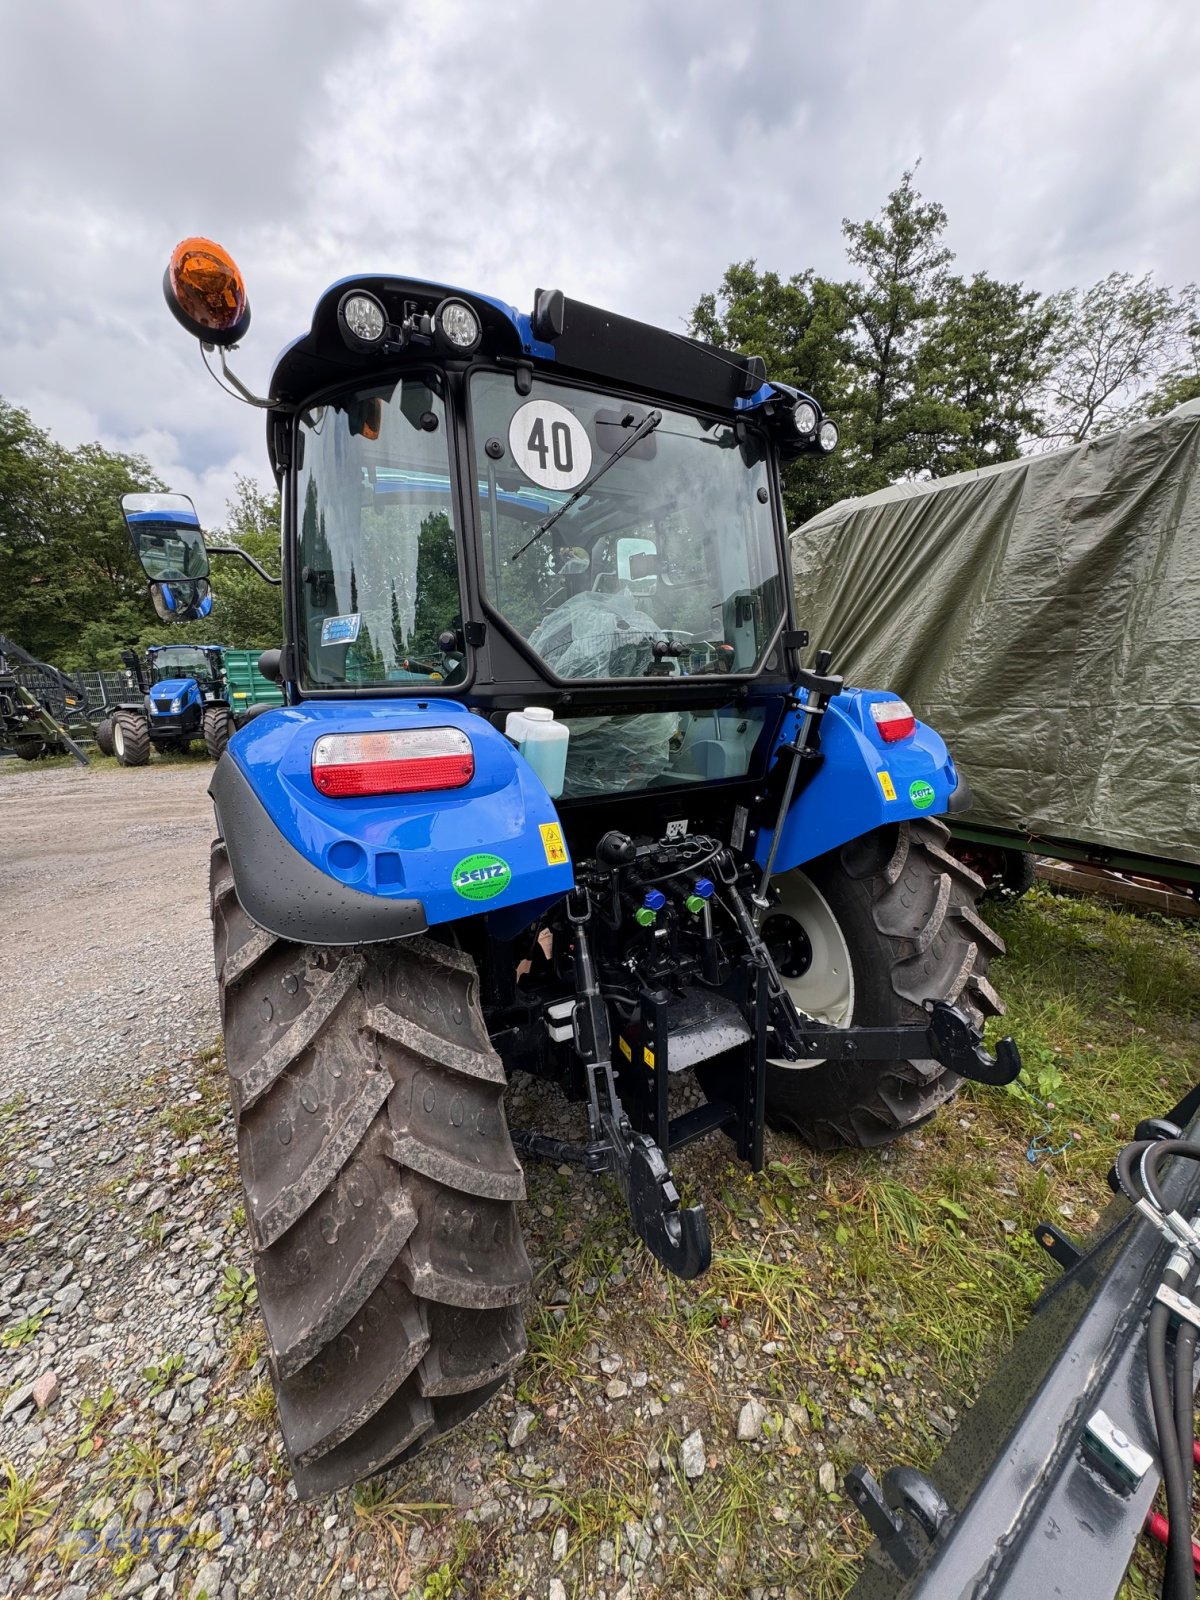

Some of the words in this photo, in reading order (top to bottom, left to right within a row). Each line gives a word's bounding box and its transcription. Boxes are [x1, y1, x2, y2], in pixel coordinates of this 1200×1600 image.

[527, 417, 574, 473] 40
[912, 787, 932, 798] SEITZ
[459, 865, 504, 884] SEITZ
